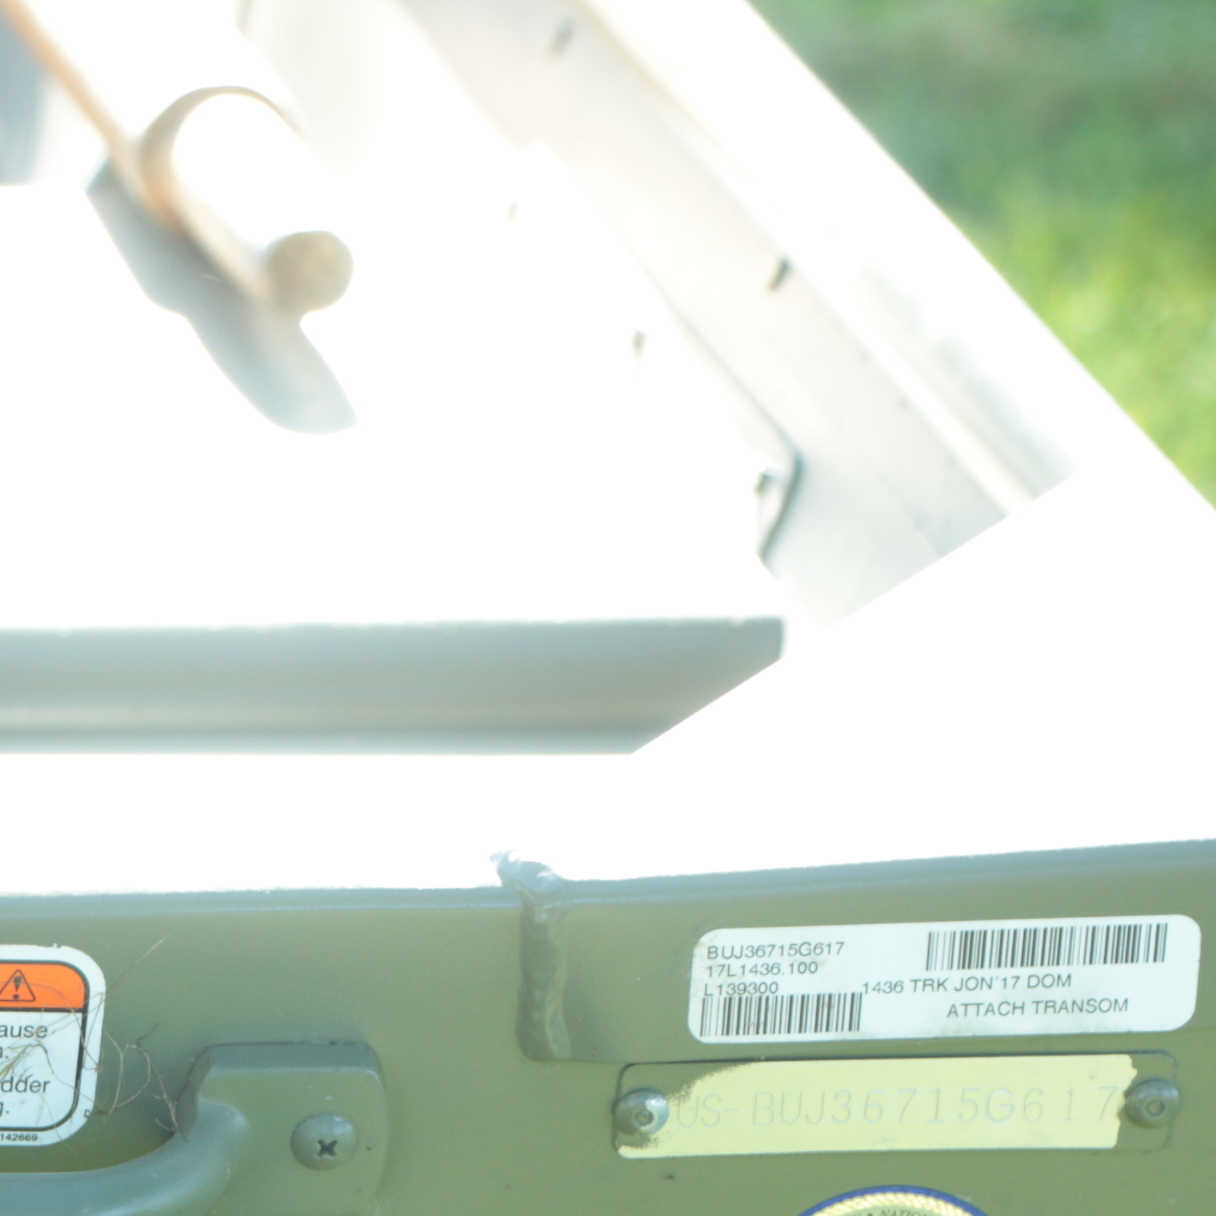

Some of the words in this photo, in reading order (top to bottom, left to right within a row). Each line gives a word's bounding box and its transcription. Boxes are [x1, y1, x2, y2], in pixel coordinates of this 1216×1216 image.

[707, 941, 845, 960] BUJ36715G617
[707, 961, 818, 978] 17L1436.100
[704, 981, 779, 997] L139300
[863, 980, 904, 994] 1436
[910, 977, 949, 993] TRK
[954, 975, 1020, 992] JON'17
[1027, 974, 1072, 989] DOM
[947, 1001, 1025, 1018] ATTACH
[1032, 998, 1129, 1015] TRANSOM
[0, 1133, 38, 1141] 142669
